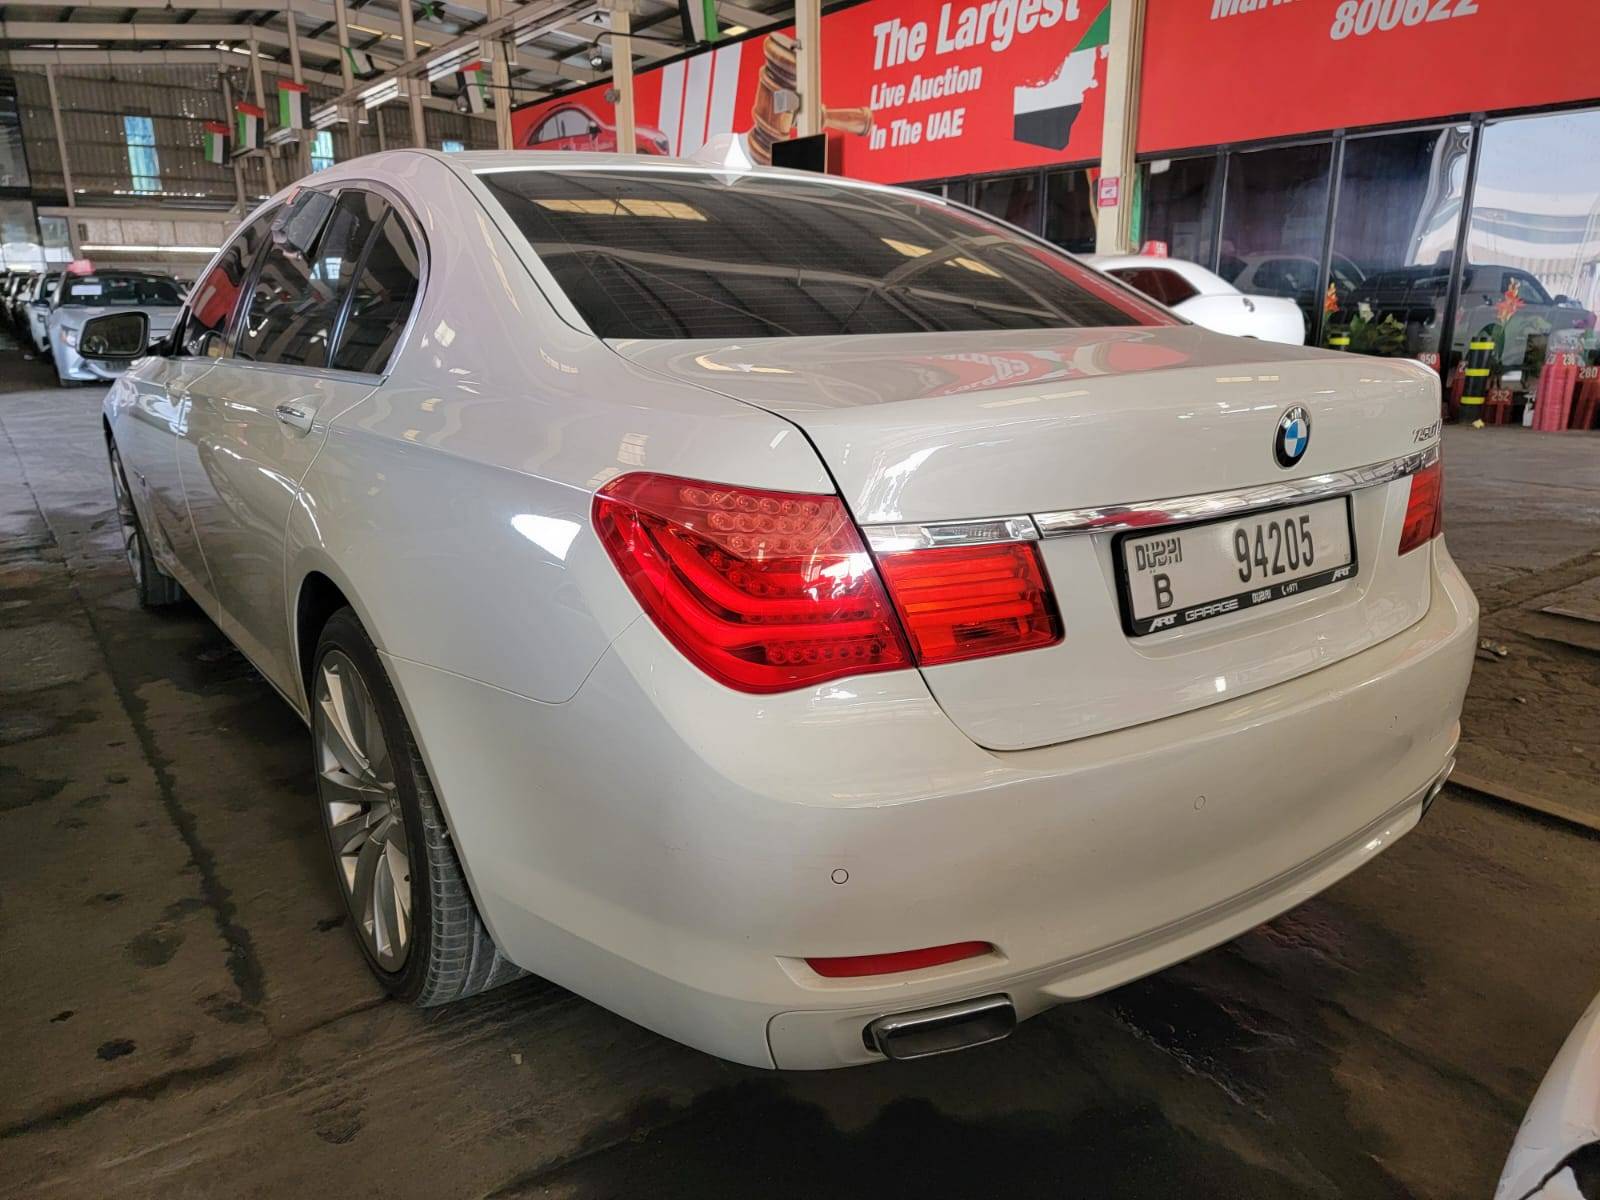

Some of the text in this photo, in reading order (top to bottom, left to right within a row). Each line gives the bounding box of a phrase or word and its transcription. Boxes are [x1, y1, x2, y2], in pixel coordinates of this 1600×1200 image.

[873, 17, 928, 71] The
[870, 65, 983, 111] Live Auction
[869, 107, 966, 151] In The UAE
[1234, 514, 1315, 583] 94205
[1153, 572, 1174, 611] B
[1184, 598, 1240, 622] GARAGE
